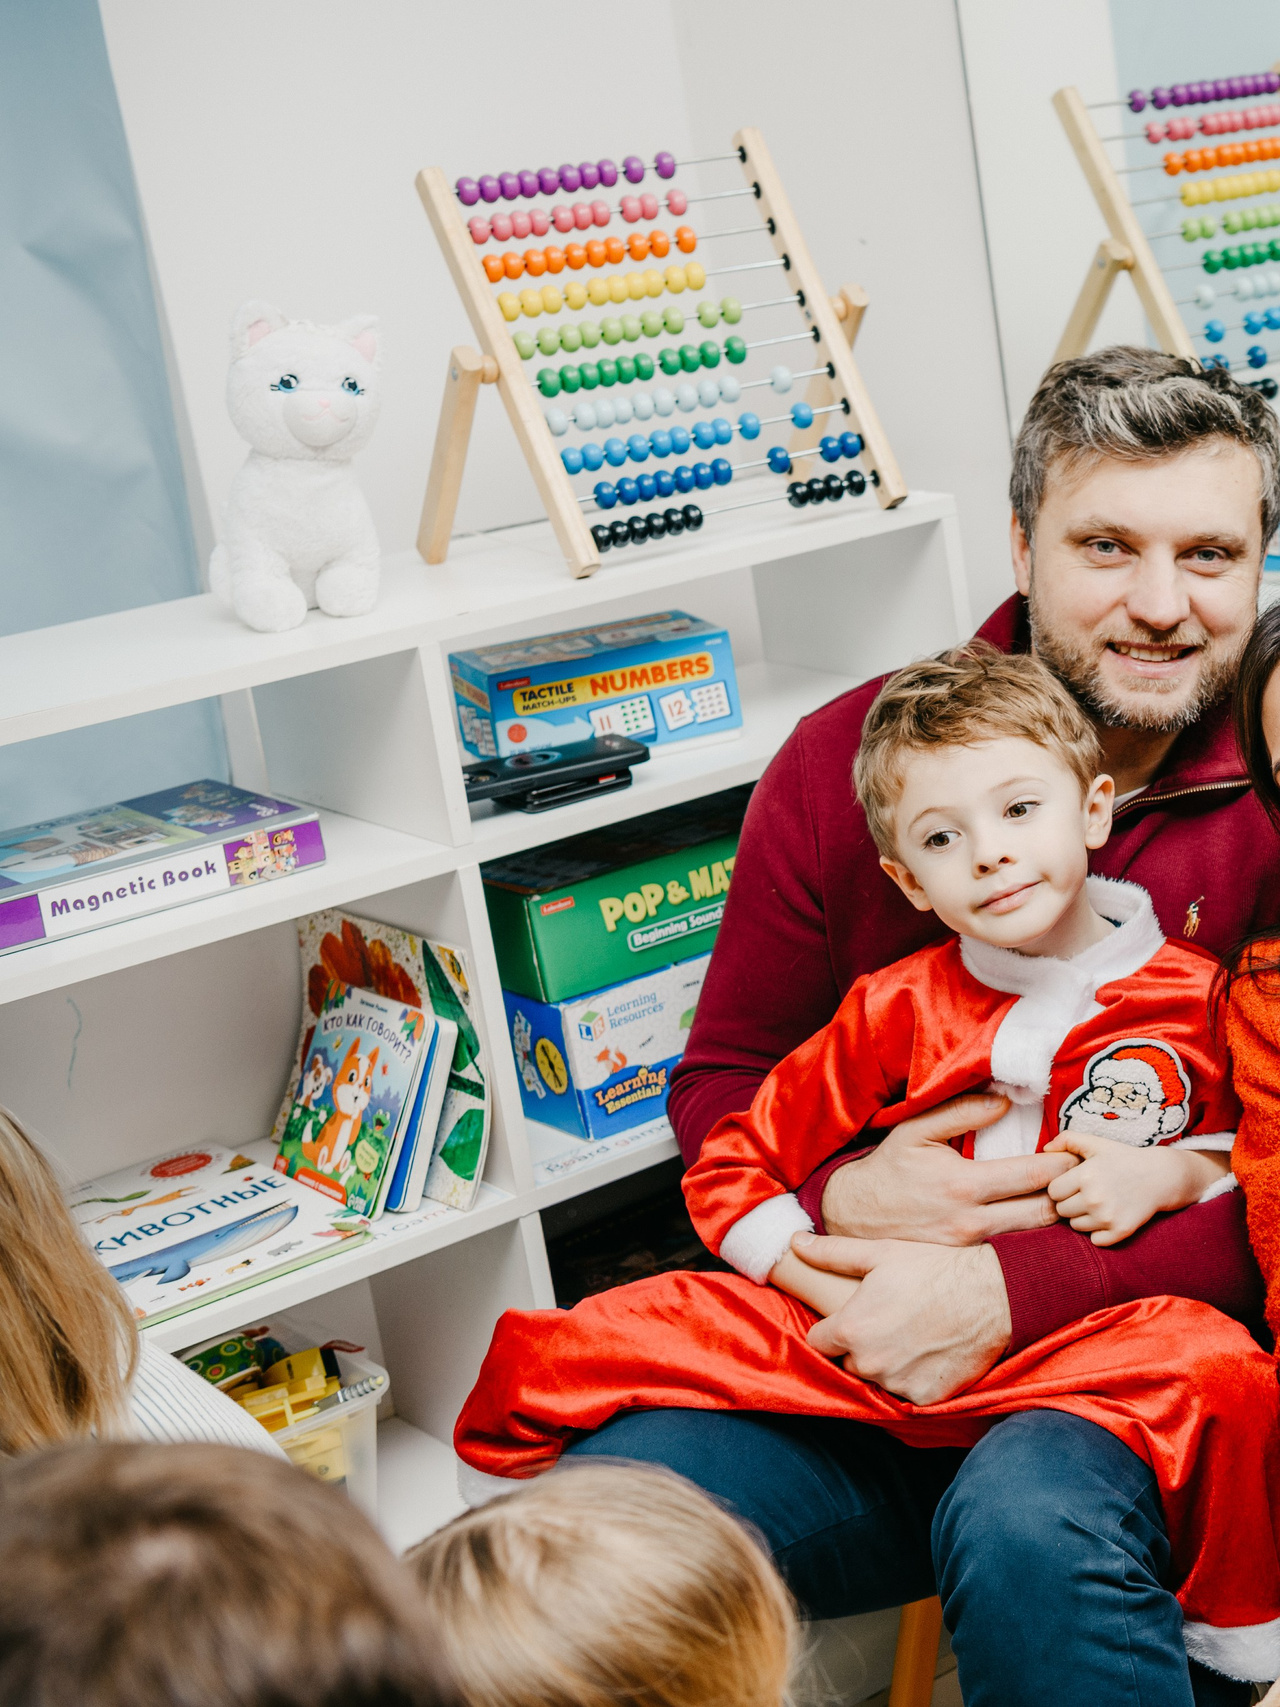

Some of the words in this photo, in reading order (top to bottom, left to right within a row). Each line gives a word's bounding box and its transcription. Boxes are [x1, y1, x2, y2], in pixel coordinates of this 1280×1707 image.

[520, 682, 575, 702] TACTILE
[590, 656, 710, 697] NUMBERS
[522, 695, 577, 711] MATCH-UPS
[668, 700, 684, 717] 12
[50, 877, 156, 917] Magnetic
[163, 859, 217, 887] Book
[599, 883, 664, 932] POP
[666, 880, 690, 905] &
[633, 920, 688, 947] Beginning
[689, 906, 724, 928] Sound
[607, 992, 657, 1017] Learning
[609, 1002, 664, 1029] Resources
[323, 1015, 343, 1031] КТО
[346, 1013, 365, 1028] КАК
[366, 1017, 412, 1063] ГОВОРИТ?
[595, 1067, 667, 1106] Learning
[605, 1085, 662, 1115] Essentials
